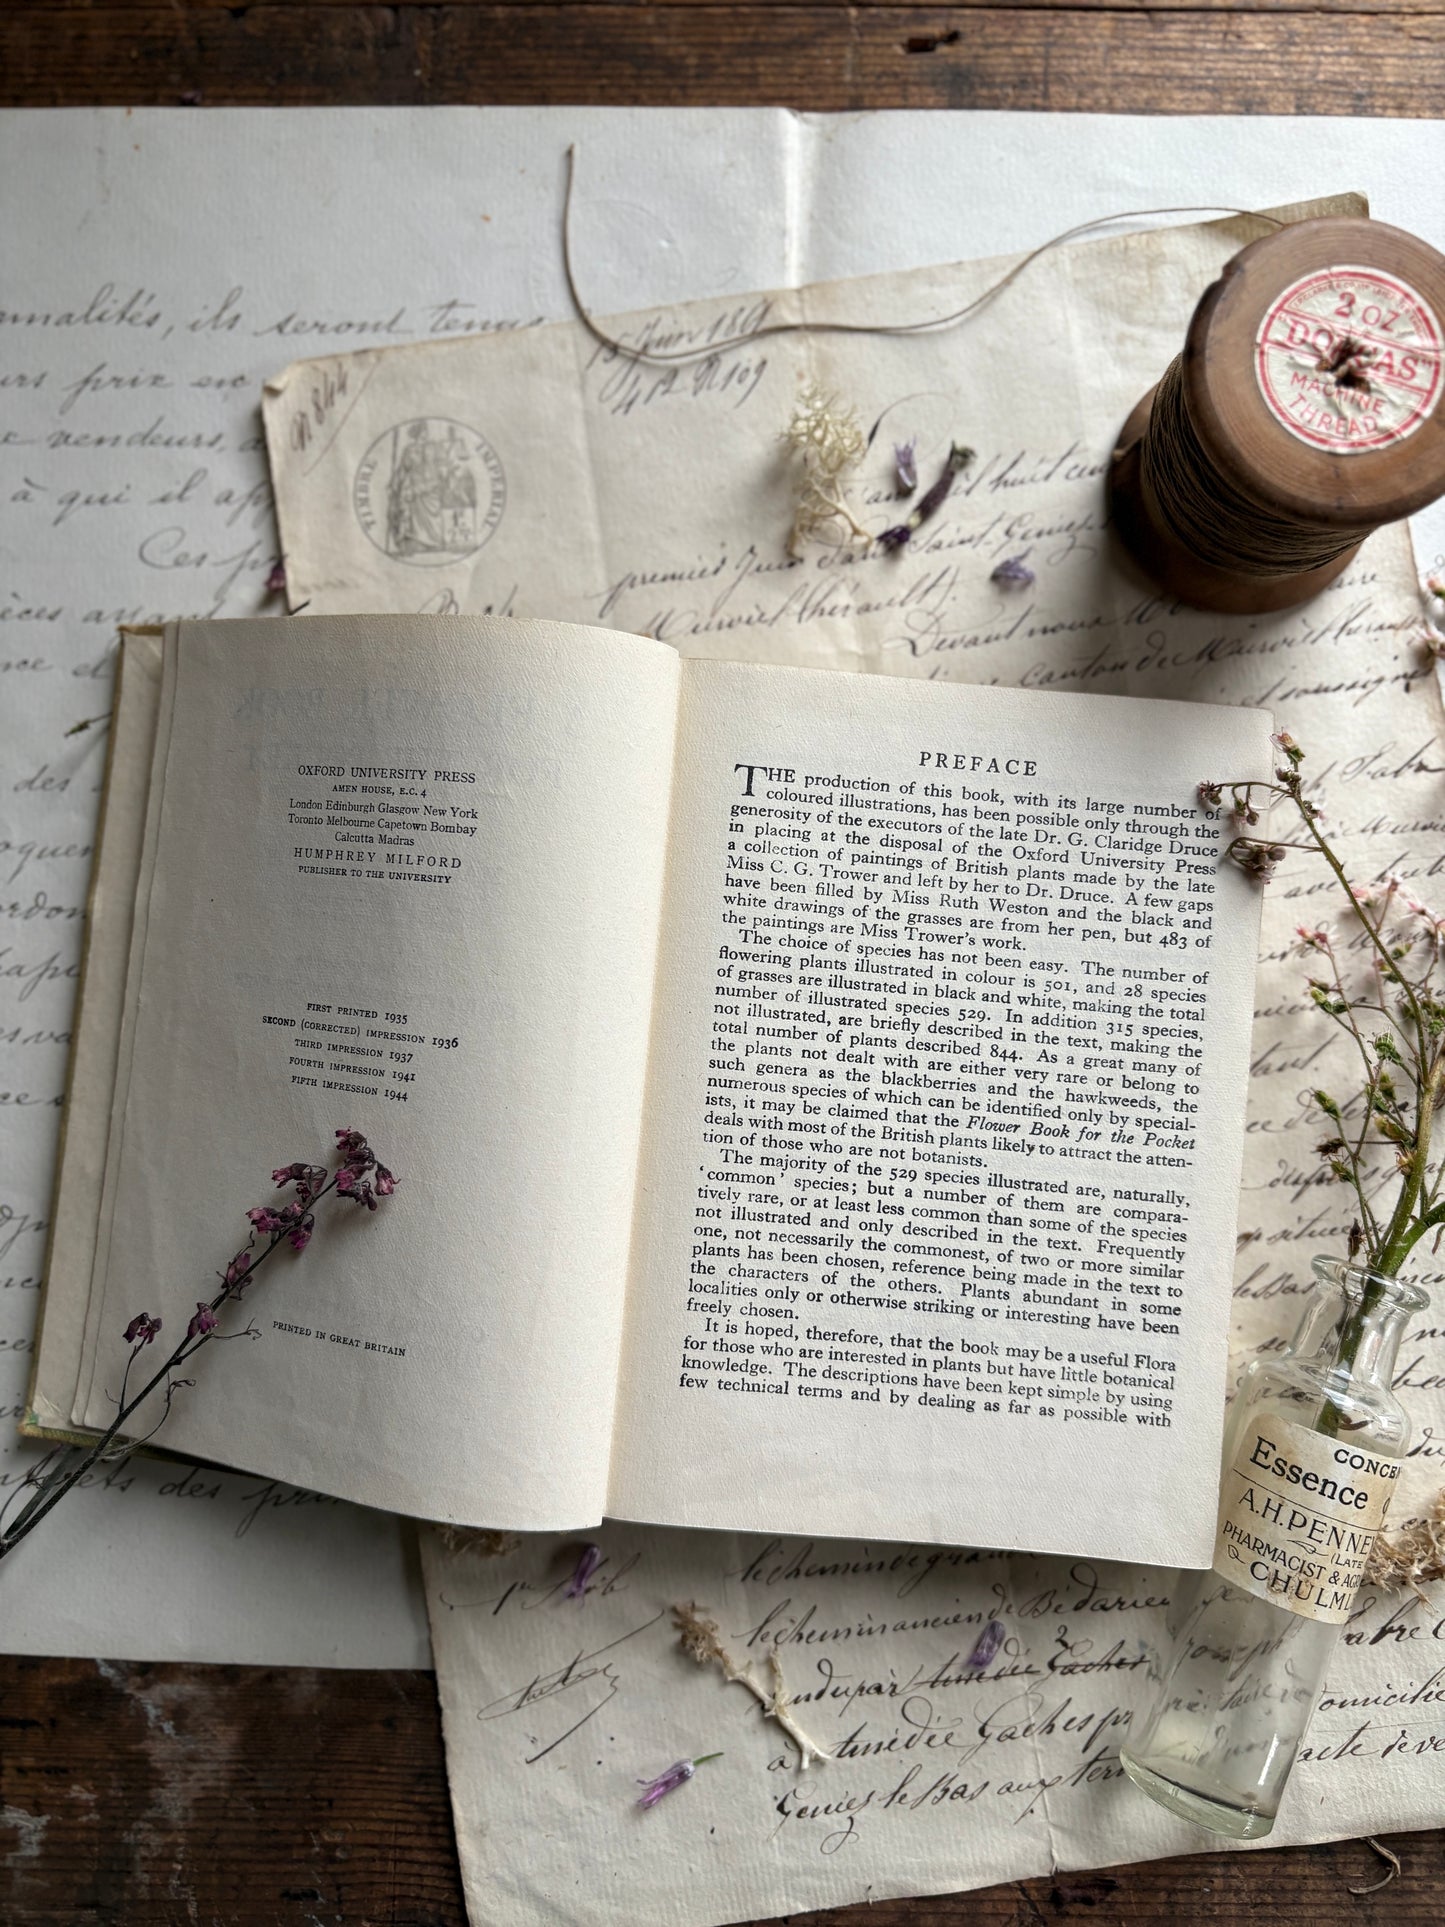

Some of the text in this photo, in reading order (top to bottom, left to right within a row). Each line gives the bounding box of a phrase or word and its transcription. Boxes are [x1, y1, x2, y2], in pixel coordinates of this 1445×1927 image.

[1334, 291, 1356, 318] 2
[1361, 305, 1400, 332] OZ
[1290, 371, 1387, 414] MACHINE
[1289, 392, 1377, 436] THREAD
[298, 765, 476, 784] OXFORD UNIVERSITY PRESS
[919, 751, 1037, 776] PREFACE
[290, 798, 478, 819] London Edinburgh Glasgow New York
[332, 784, 427, 798] AMEN HOUSE, E.C. 4
[804, 773, 890, 793] production
[898, 780, 917, 795] of
[923, 782, 952, 799] this
[961, 785, 1004, 806] book,
[1012, 791, 1049, 807] with
[1056, 794, 1077, 809] its
[1084, 796, 1125, 816] large
[1133, 802, 1197, 819] number
[1204, 807, 1223, 822] of
[288, 813, 478, 837] Toronto Melbourne Capetown Bombay
[335, 832, 415, 846] Calcutta Madras
[294, 847, 461, 868] HUMPHREY MILFORD
[298, 865, 452, 884] PUBLISHER TO THE UNIVERSITY
[724, 872, 1212, 930] have been filled by Miss Ruth Weston and the black and
[307, 1003, 408, 1025] FIRST PRINTED 1935
[714, 984, 1203, 1042] number of illustrated species 529. In addition 315 species,
[262, 1015, 459, 1050] SECOND (CORRECTED) IMPRESSION 1936
[294, 1038, 413, 1063] THIRD IMPRESSION 1937
[289, 1056, 416, 1083] FOURTH IMPRESSION 1941
[291, 1075, 408, 1102] FIFTH IMPRESSION 1944
[704, 1090, 1196, 1150] ists, it may be claimed that the Flower Book for the Pocket
[694, 1205, 1186, 1264] not illustrated and only described in the text. Frequently
[273, 1321, 406, 1357] PRINTED IN GREAT BRITAIN
[678, 1372, 1171, 1428] few technical terms and by dealing as far as possible with
[1250, 1435, 1369, 1510] Essence
[1222, 1520, 1327, 1580] PHARMACIST
[1328, 1570, 1341, 1586] &
